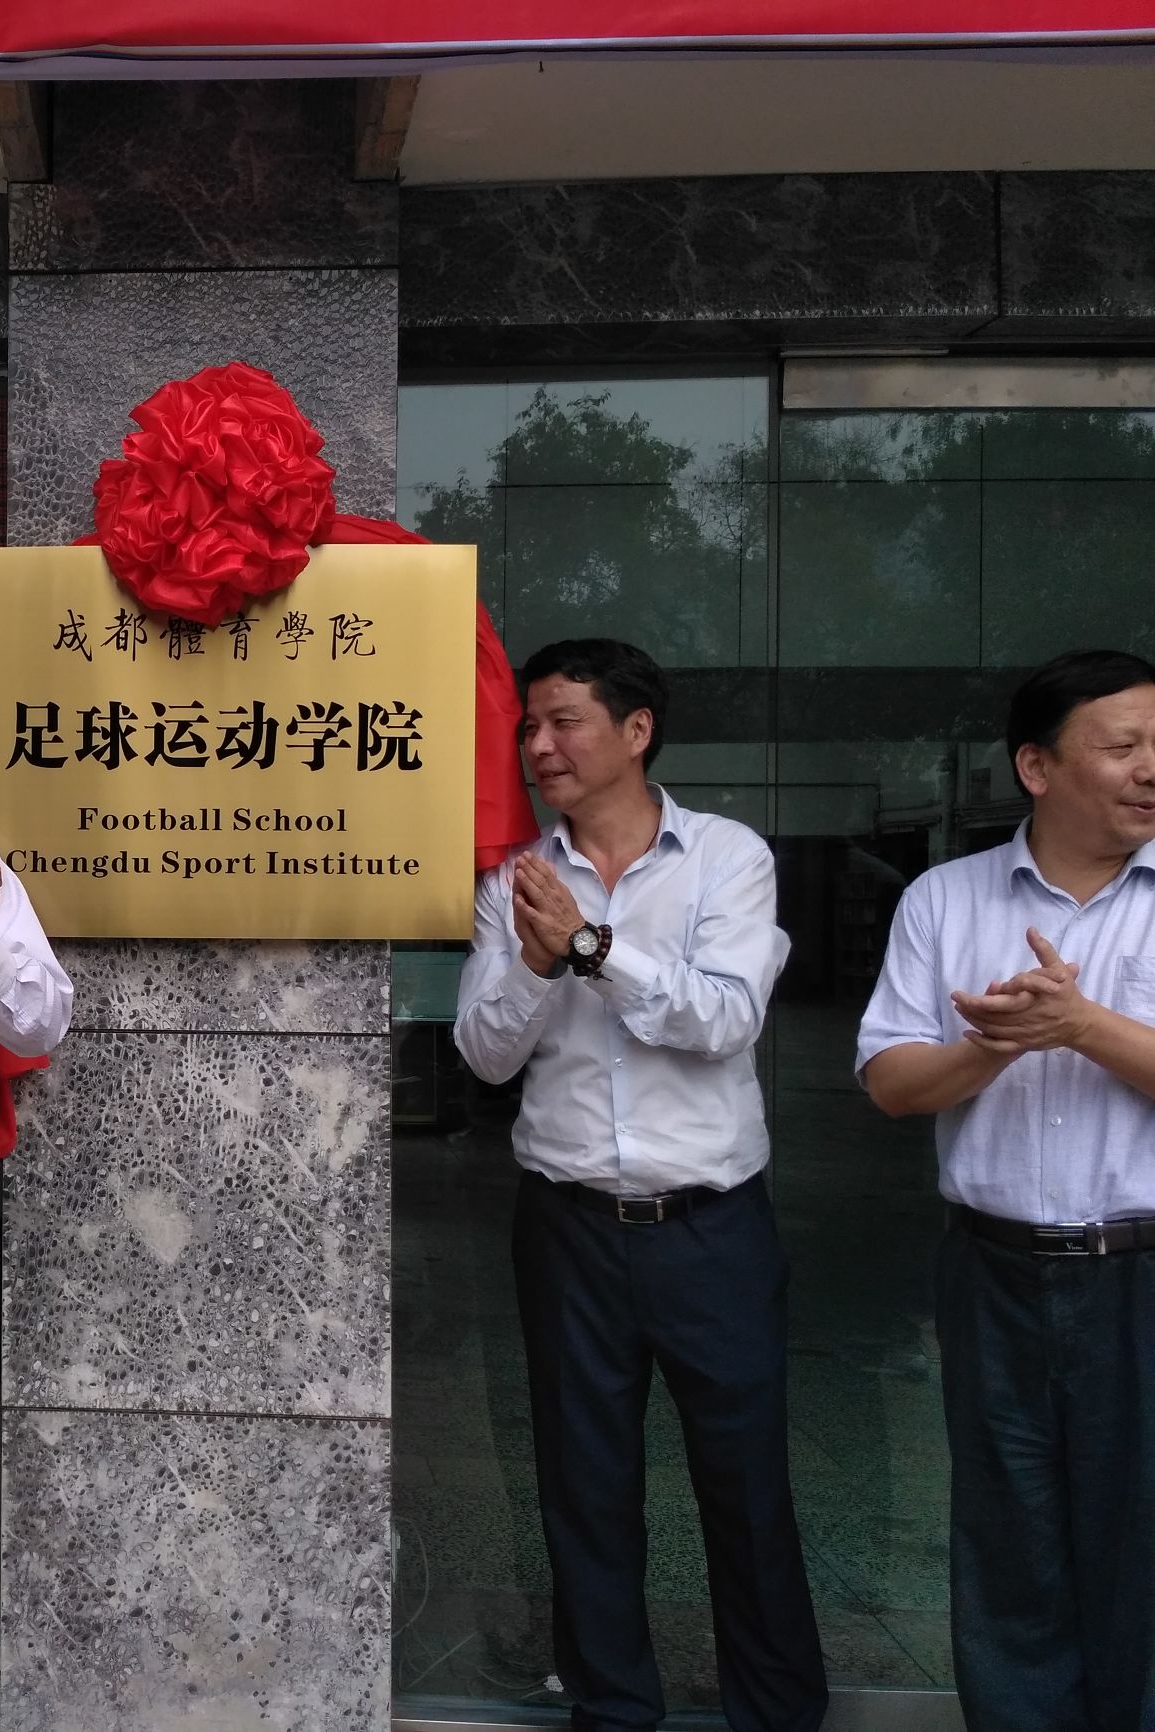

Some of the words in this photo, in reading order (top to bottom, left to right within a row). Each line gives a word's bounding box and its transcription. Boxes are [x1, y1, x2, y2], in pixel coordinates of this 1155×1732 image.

[5, 700, 423, 772] 足球运动学院
[77, 807, 223, 832] Football
[233, 808, 348, 832] School
[5, 849, 151, 879] Chengdu
[161, 850, 256, 879] Sport
[266, 851, 420, 876] Institute
